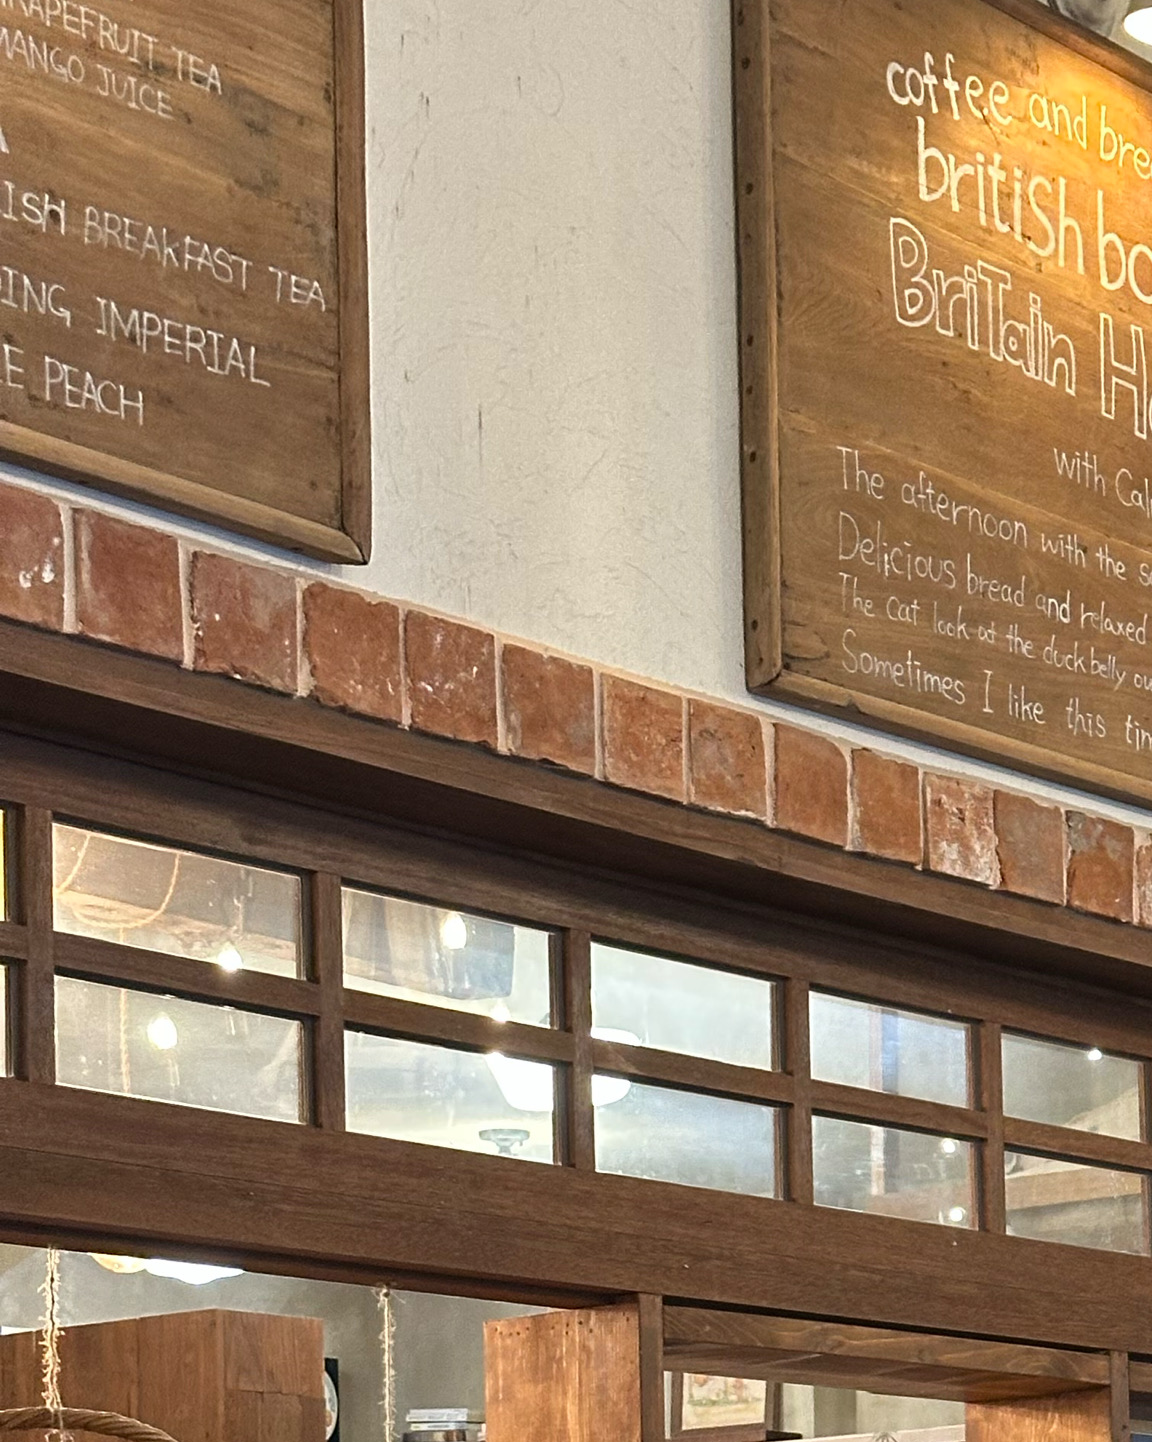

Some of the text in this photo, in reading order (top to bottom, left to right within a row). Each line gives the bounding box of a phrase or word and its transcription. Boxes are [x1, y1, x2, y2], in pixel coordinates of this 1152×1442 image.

[97, 64, 176, 120] JUICE
[171, 46, 223, 95] TEA
[886, 51, 1013, 126] coffee
[1028, 95, 1088, 150] and
[84, 206, 253, 290] BREAKFAST
[268, 266, 326, 312] TEA
[44, 355, 144, 426] PEACH
[96, 297, 271, 387] IMPERIAL
[836, 445, 885, 500] The
[901, 470, 1028, 548] afternoon
[1041, 531, 1086, 569] with
[1095, 546, 1127, 582] the
[1053, 447, 1106, 497] with
[838, 511, 956, 590] Delicious
[966, 553, 1026, 608] bread
[1035, 591, 1071, 624] and
[1080, 601, 1147, 646] relaxed
[839, 572, 874, 618] The
[932, 606, 970, 640] look
[976, 620, 997, 644] at
[1005, 625, 1036, 659] the
[1042, 635, 1085, 674] duck
[1089, 648, 1127, 692] belly
[841, 629, 966, 704] Sometimes
[982, 670, 995, 713] I
[1007, 685, 1046, 724] like
[1065, 698, 1106, 737] this
